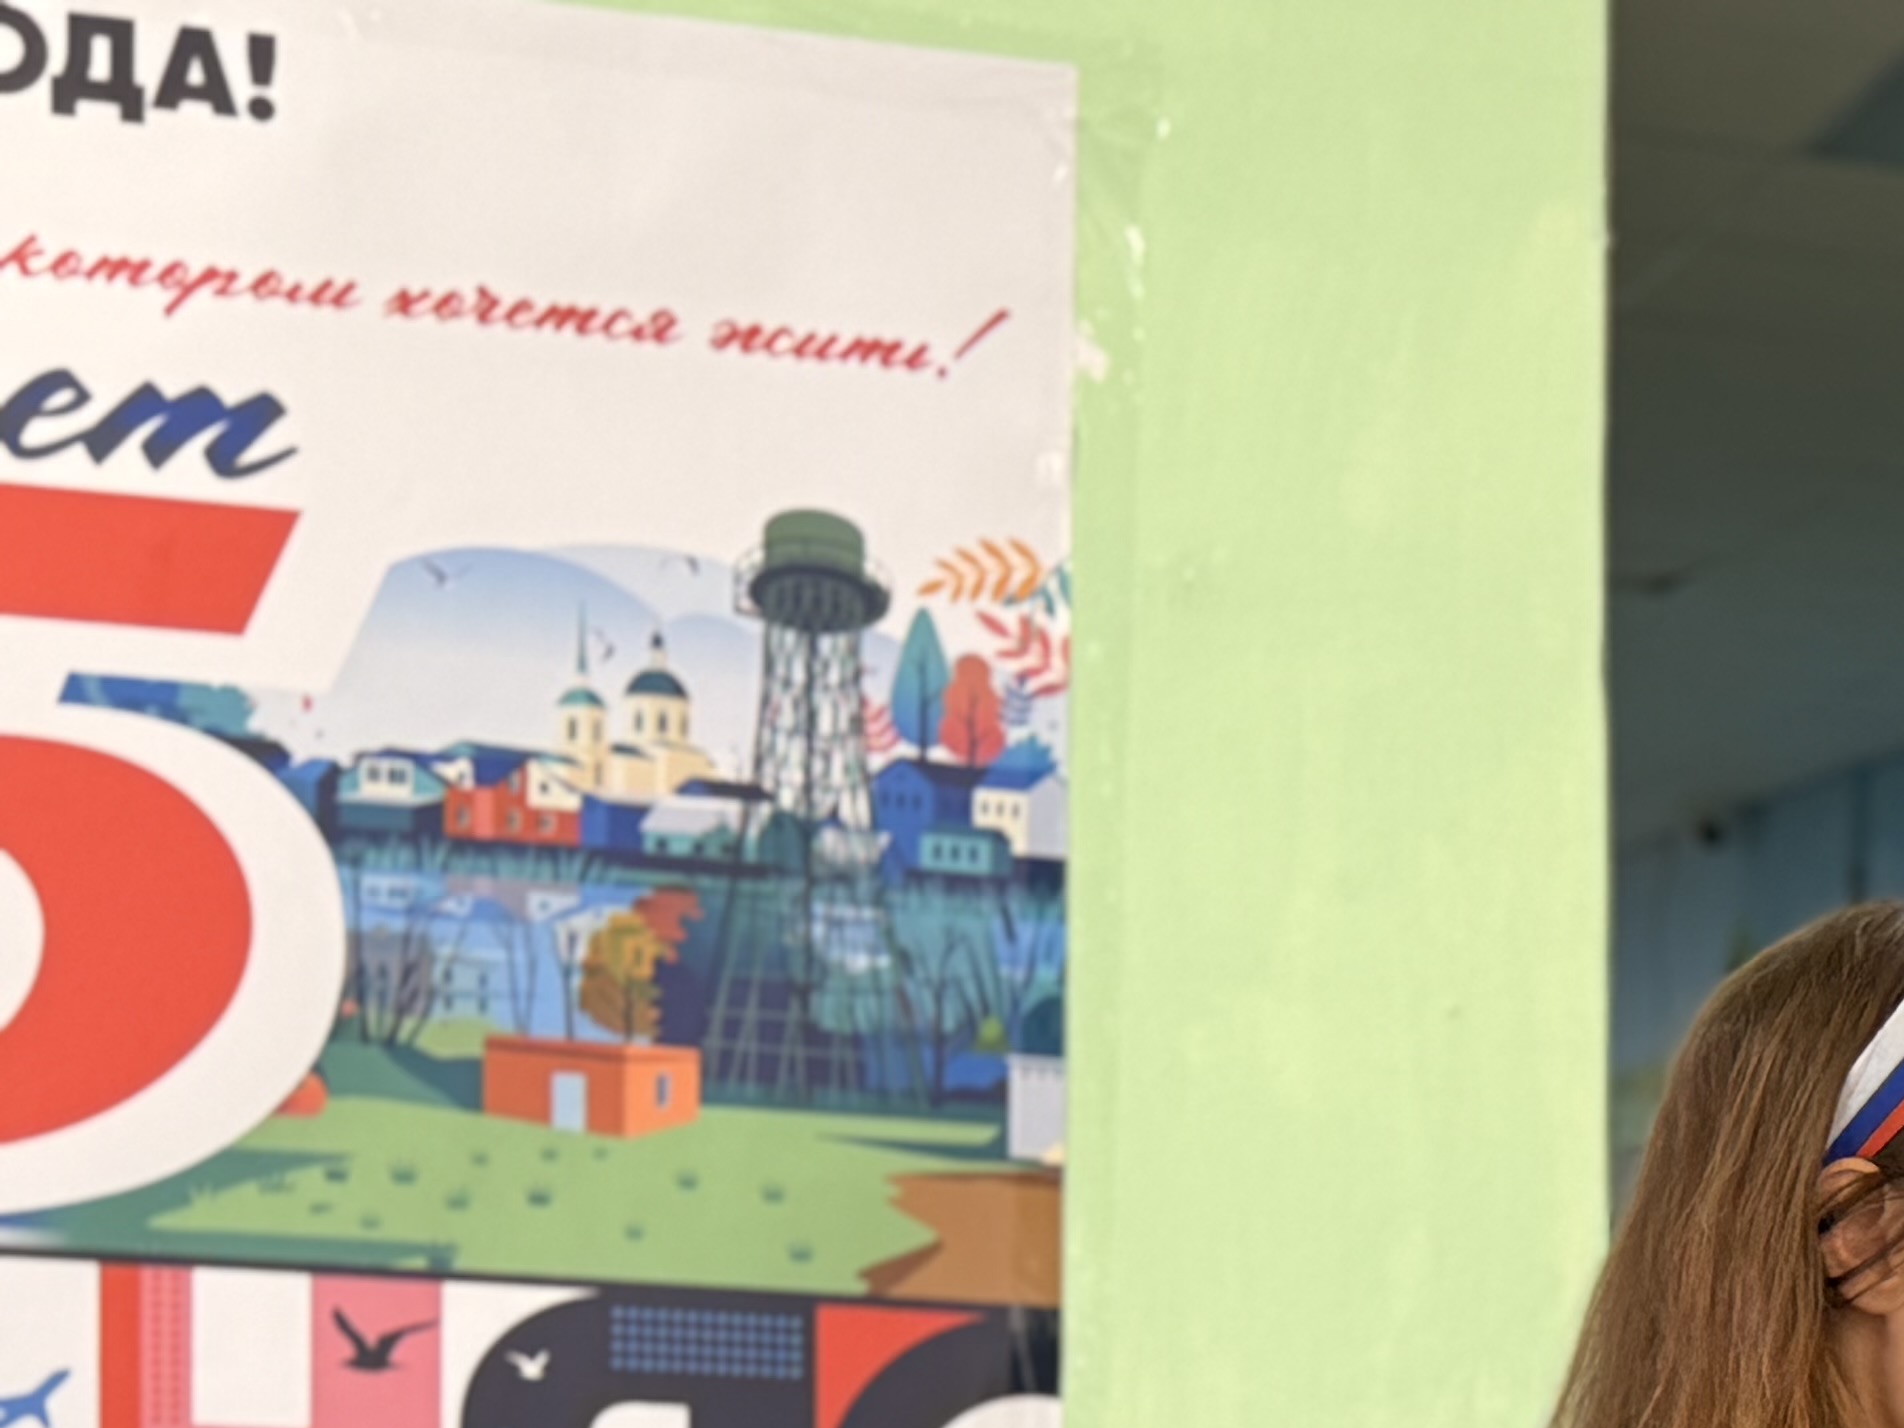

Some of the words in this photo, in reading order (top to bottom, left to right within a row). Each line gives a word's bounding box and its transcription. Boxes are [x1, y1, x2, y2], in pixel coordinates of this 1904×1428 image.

[0, 233, 360, 318] котором
[384, 285, 682, 346] хочется
[708, 308, 1010, 379] жить!
